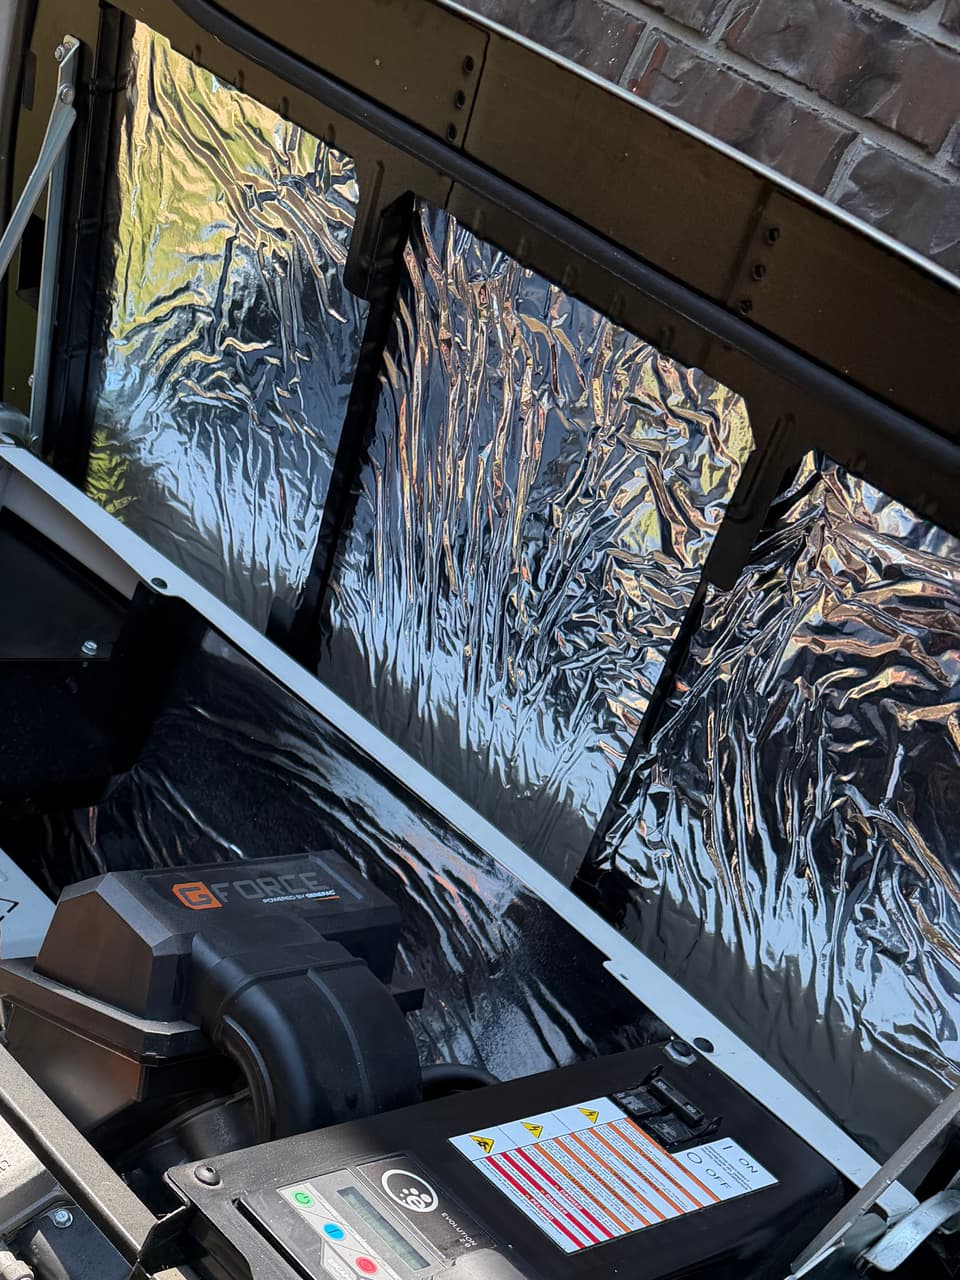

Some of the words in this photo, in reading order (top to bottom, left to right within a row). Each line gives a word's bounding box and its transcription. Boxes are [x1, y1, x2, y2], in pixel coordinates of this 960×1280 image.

[211, 872, 328, 902] FORCE
[262, 895, 296, 903] POWERED
[305, 889, 336, 898] GENERAC
[738, 1158, 759, 1173] ON
[705, 1168, 732, 1188] OFF
[530, 1198, 554, 1220] PELIGRO
[545, 1193, 568, 1215] DANGER
[560, 1189, 583, 1210] DANGER
[441, 1212, 477, 1246] EVOLUTION
